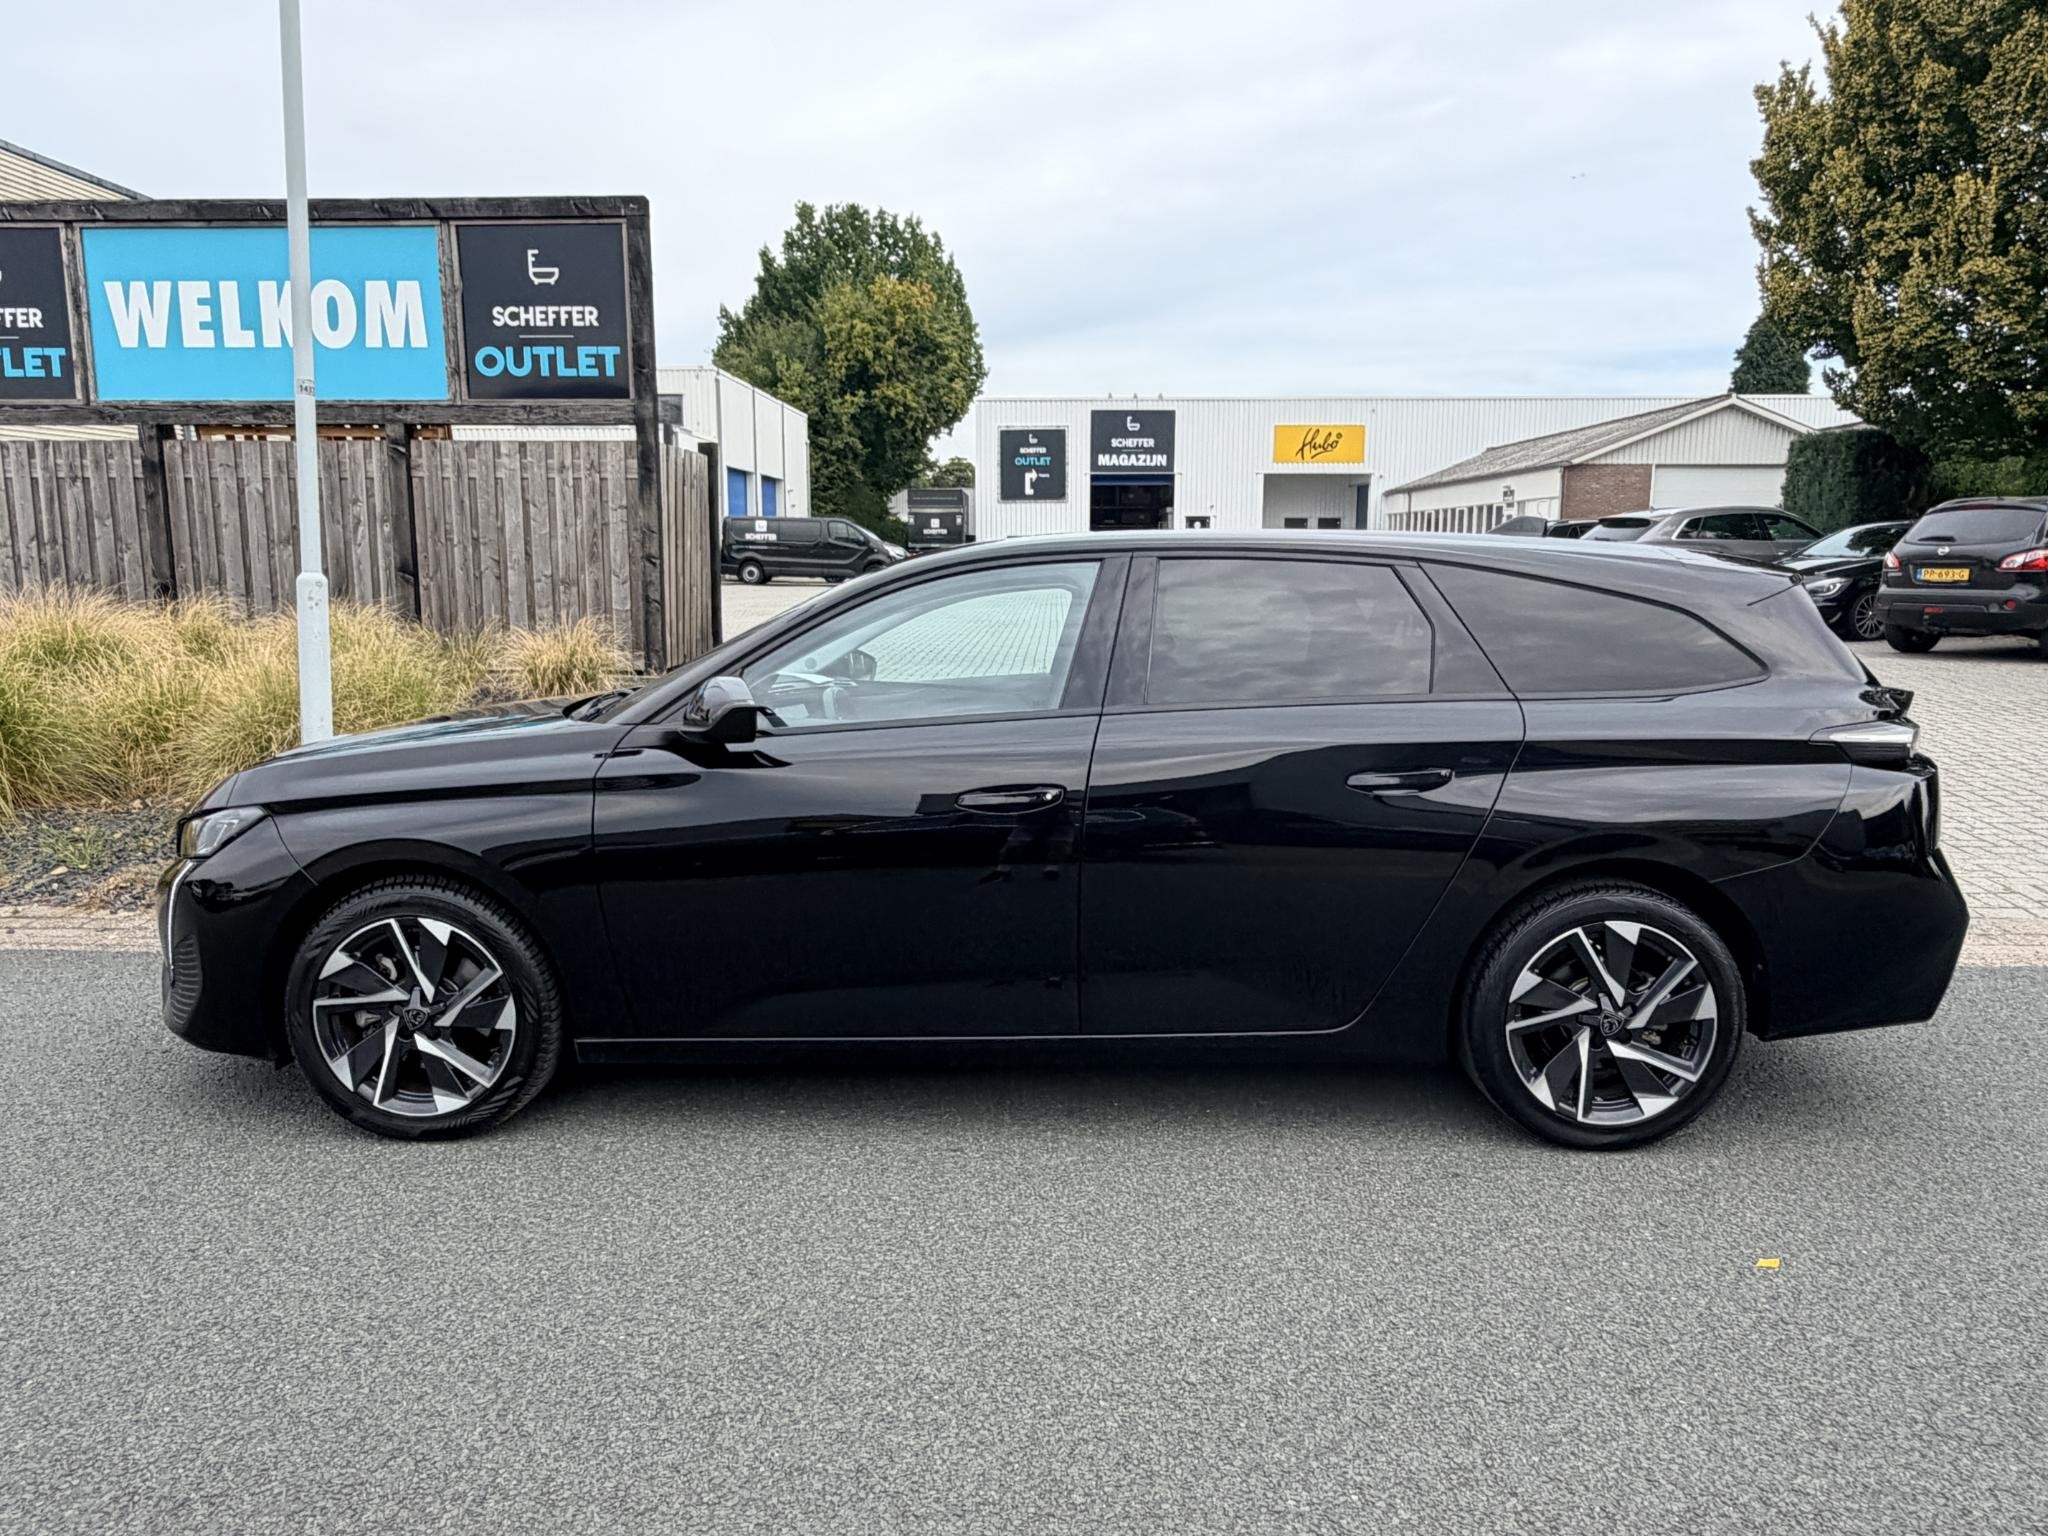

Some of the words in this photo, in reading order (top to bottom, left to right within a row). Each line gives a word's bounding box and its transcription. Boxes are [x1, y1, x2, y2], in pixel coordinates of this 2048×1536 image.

[104, 279, 428, 349] WELKOM
[492, 306, 599, 327] SCHEFFER
[475, 346, 620, 377] OUTLET
[1111, 438, 1155, 448] SCHEFFER
[1014, 456, 1051, 466] OUTLET
[1098, 454, 1168, 467] MAGAZIJN
